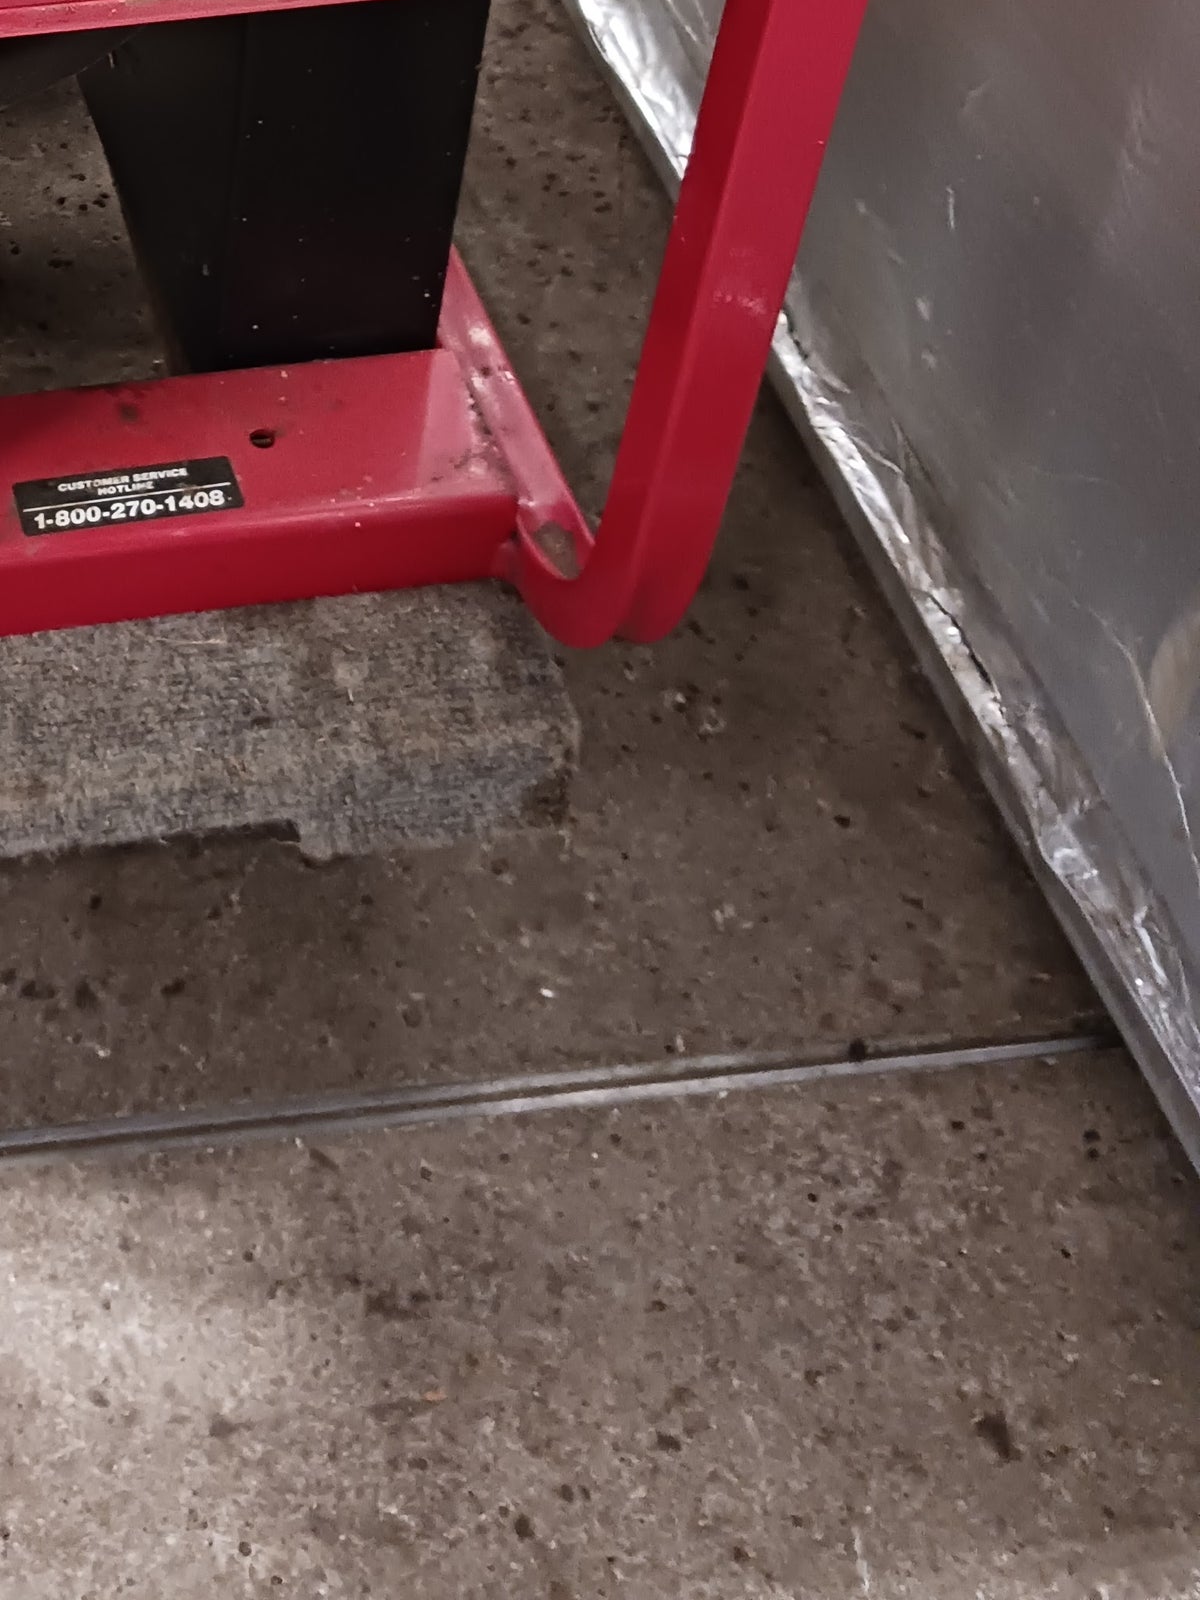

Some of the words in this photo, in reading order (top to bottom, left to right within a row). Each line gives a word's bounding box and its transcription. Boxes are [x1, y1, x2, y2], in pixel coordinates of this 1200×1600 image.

[57, 475, 130, 493] CUSTOMER
[132, 467, 188, 483] SERVICE
[97, 481, 155, 497] HOTLINE
[33, 488, 226, 530] 1-800-270-1408
